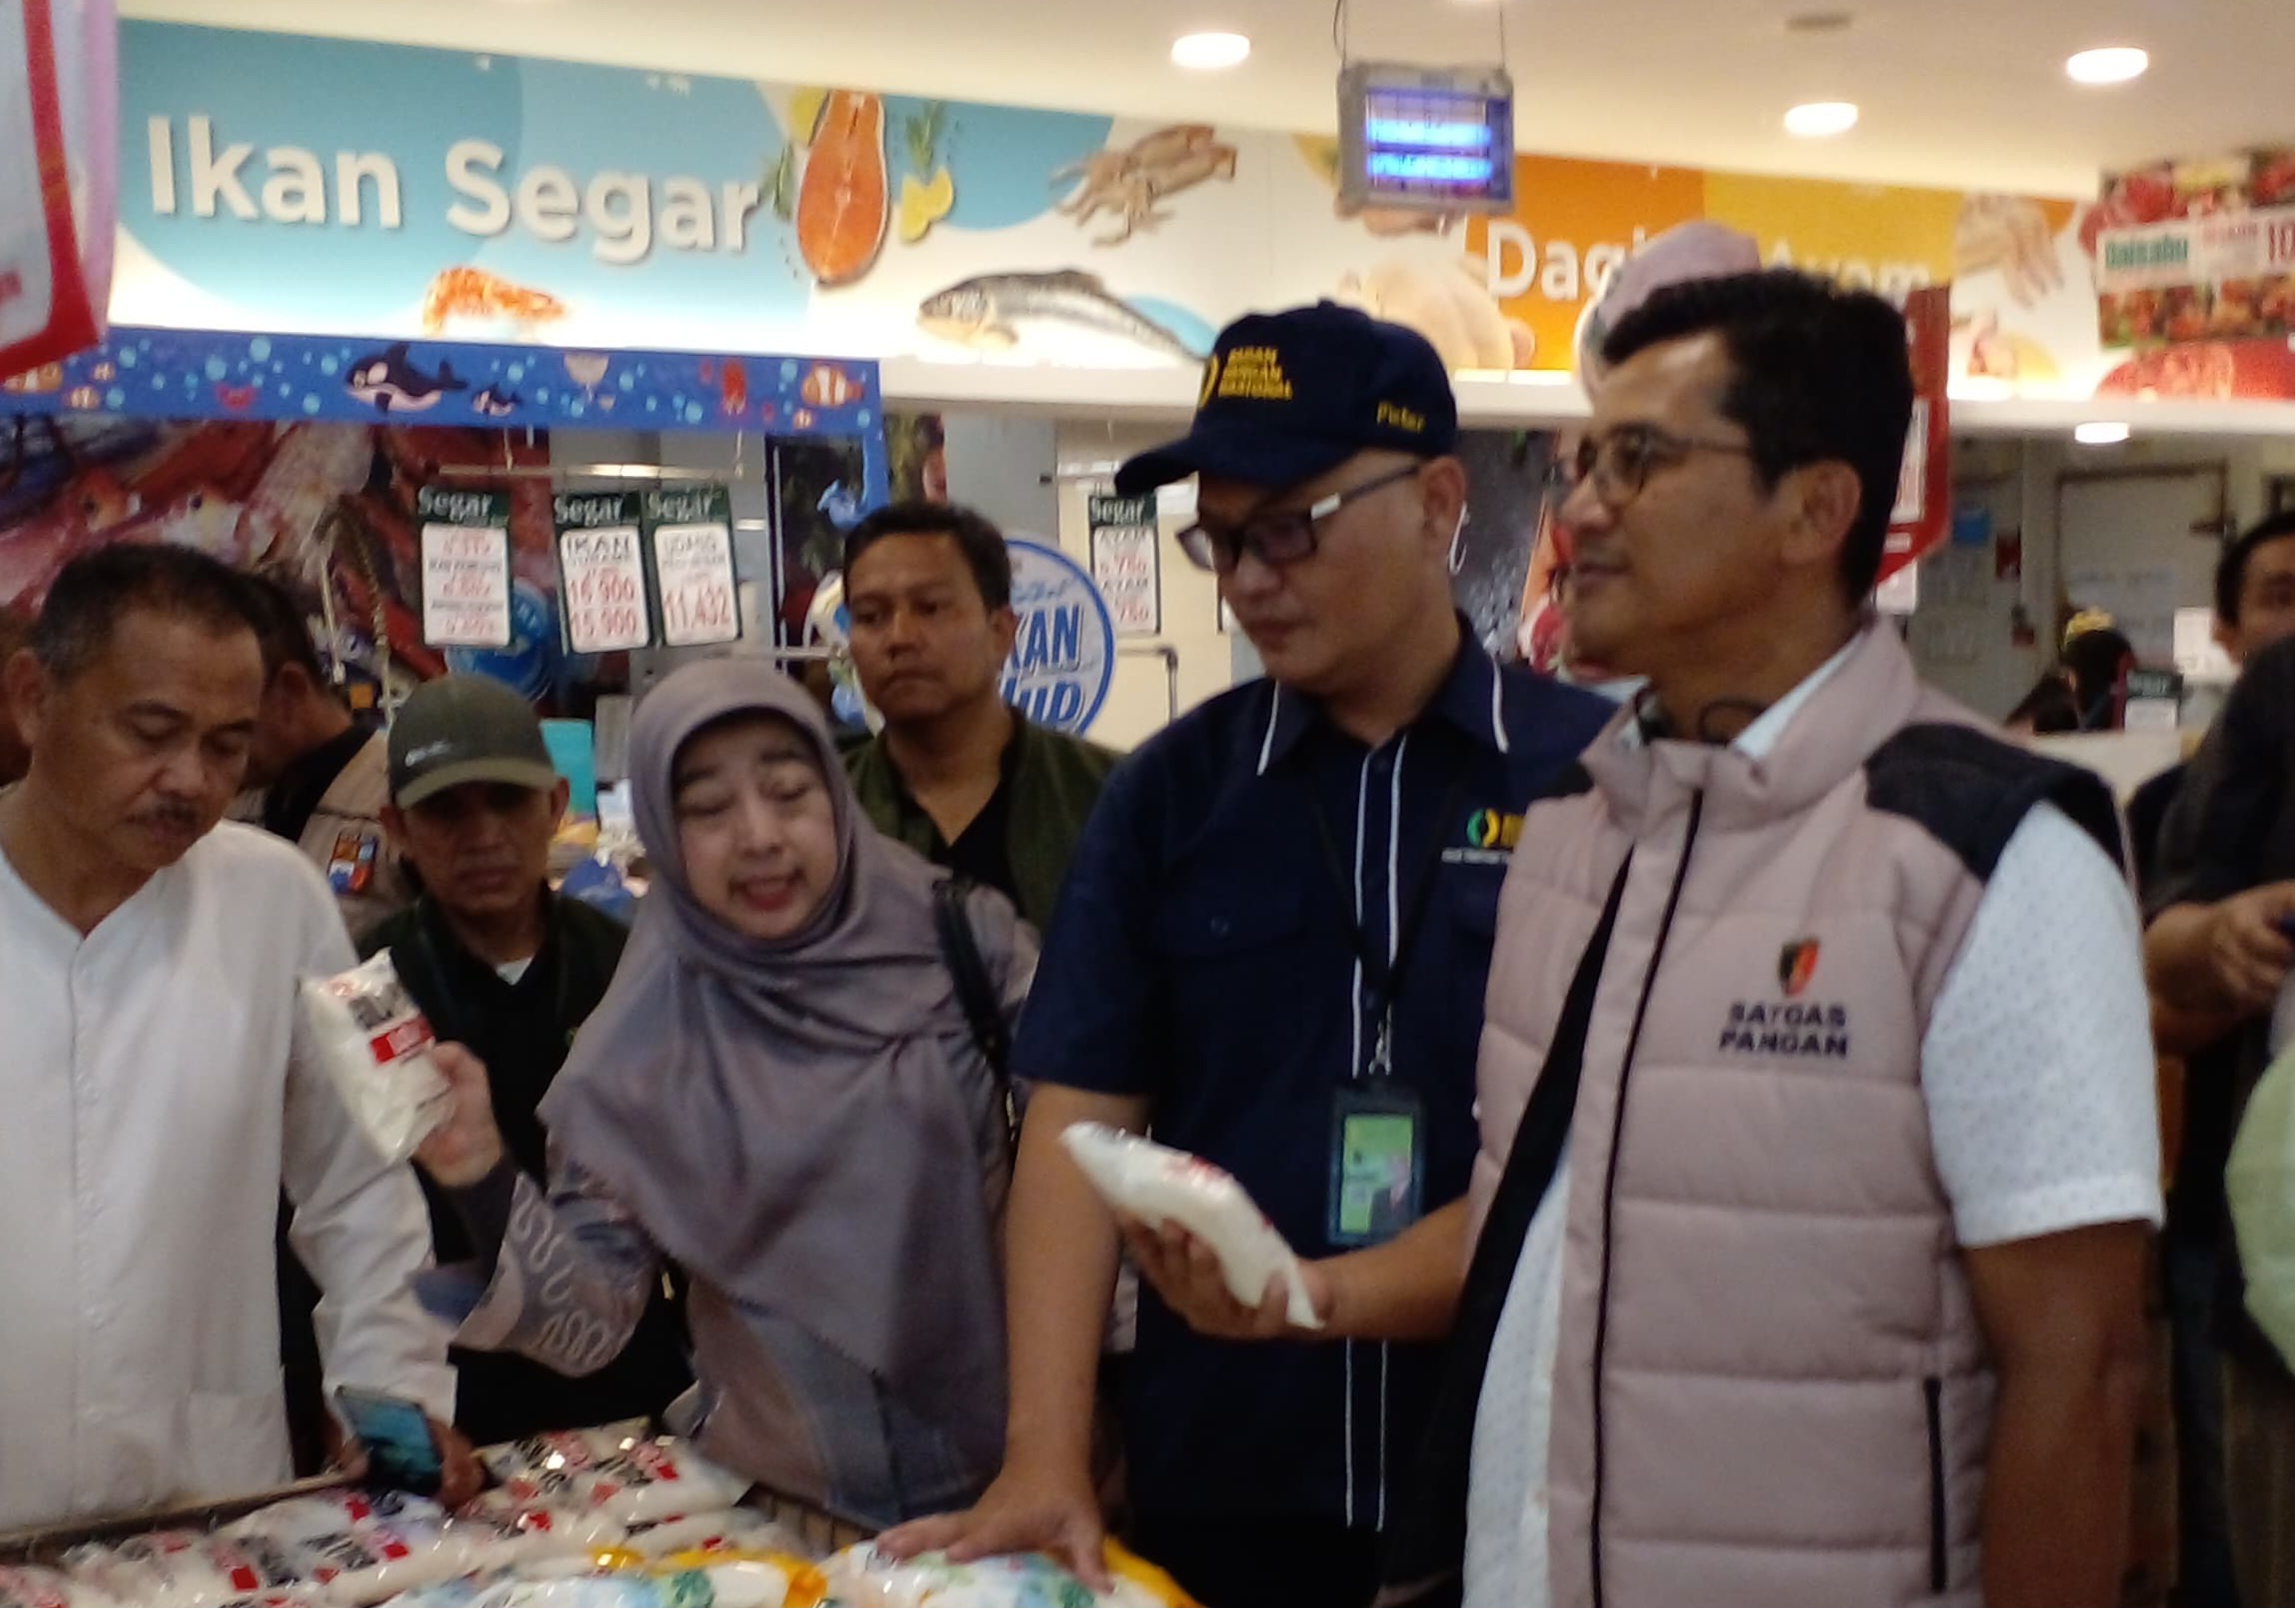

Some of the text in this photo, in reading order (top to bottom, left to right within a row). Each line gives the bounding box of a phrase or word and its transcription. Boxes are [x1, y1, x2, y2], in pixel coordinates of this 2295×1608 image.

[146, 115, 764, 266] Ikan Segar
[1730, 1003, 1847, 1028] SATGAS
[1718, 1031, 1848, 1058] PANGAN
